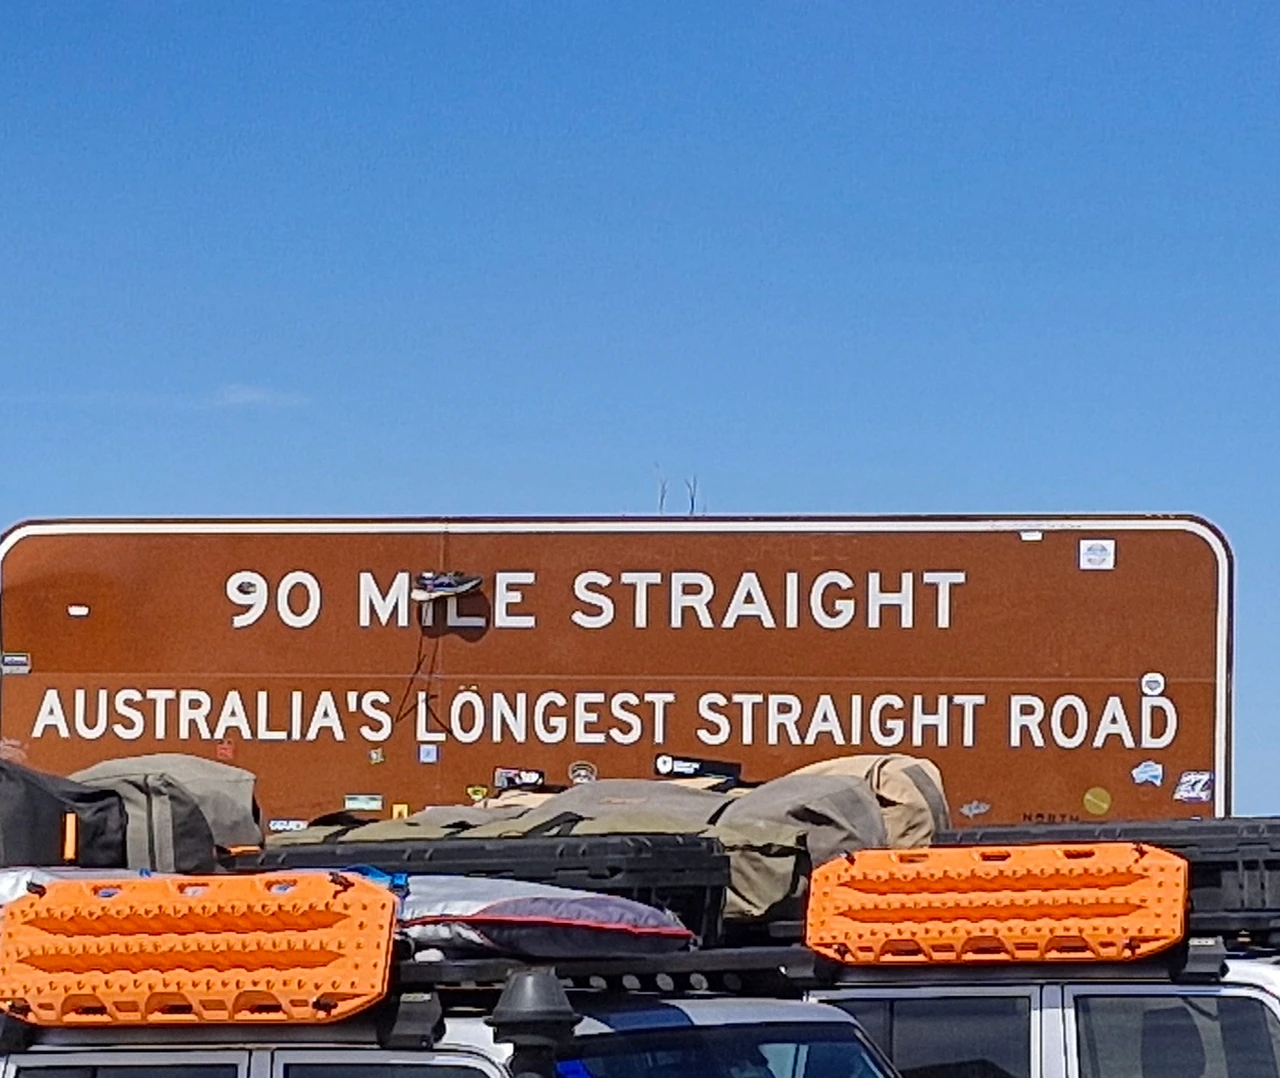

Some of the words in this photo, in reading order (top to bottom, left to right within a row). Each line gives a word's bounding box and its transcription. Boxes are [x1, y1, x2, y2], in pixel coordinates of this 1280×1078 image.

[226, 570, 321, 628] 90
[359, 571, 536, 628] MILE
[571, 570, 966, 629] STRAIGHT
[31, 688, 392, 741] AUSTRALIA'S
[416, 691, 676, 745] LONGEST
[696, 693, 986, 747] STRAIGHT
[1010, 694, 1178, 749] ROAD
